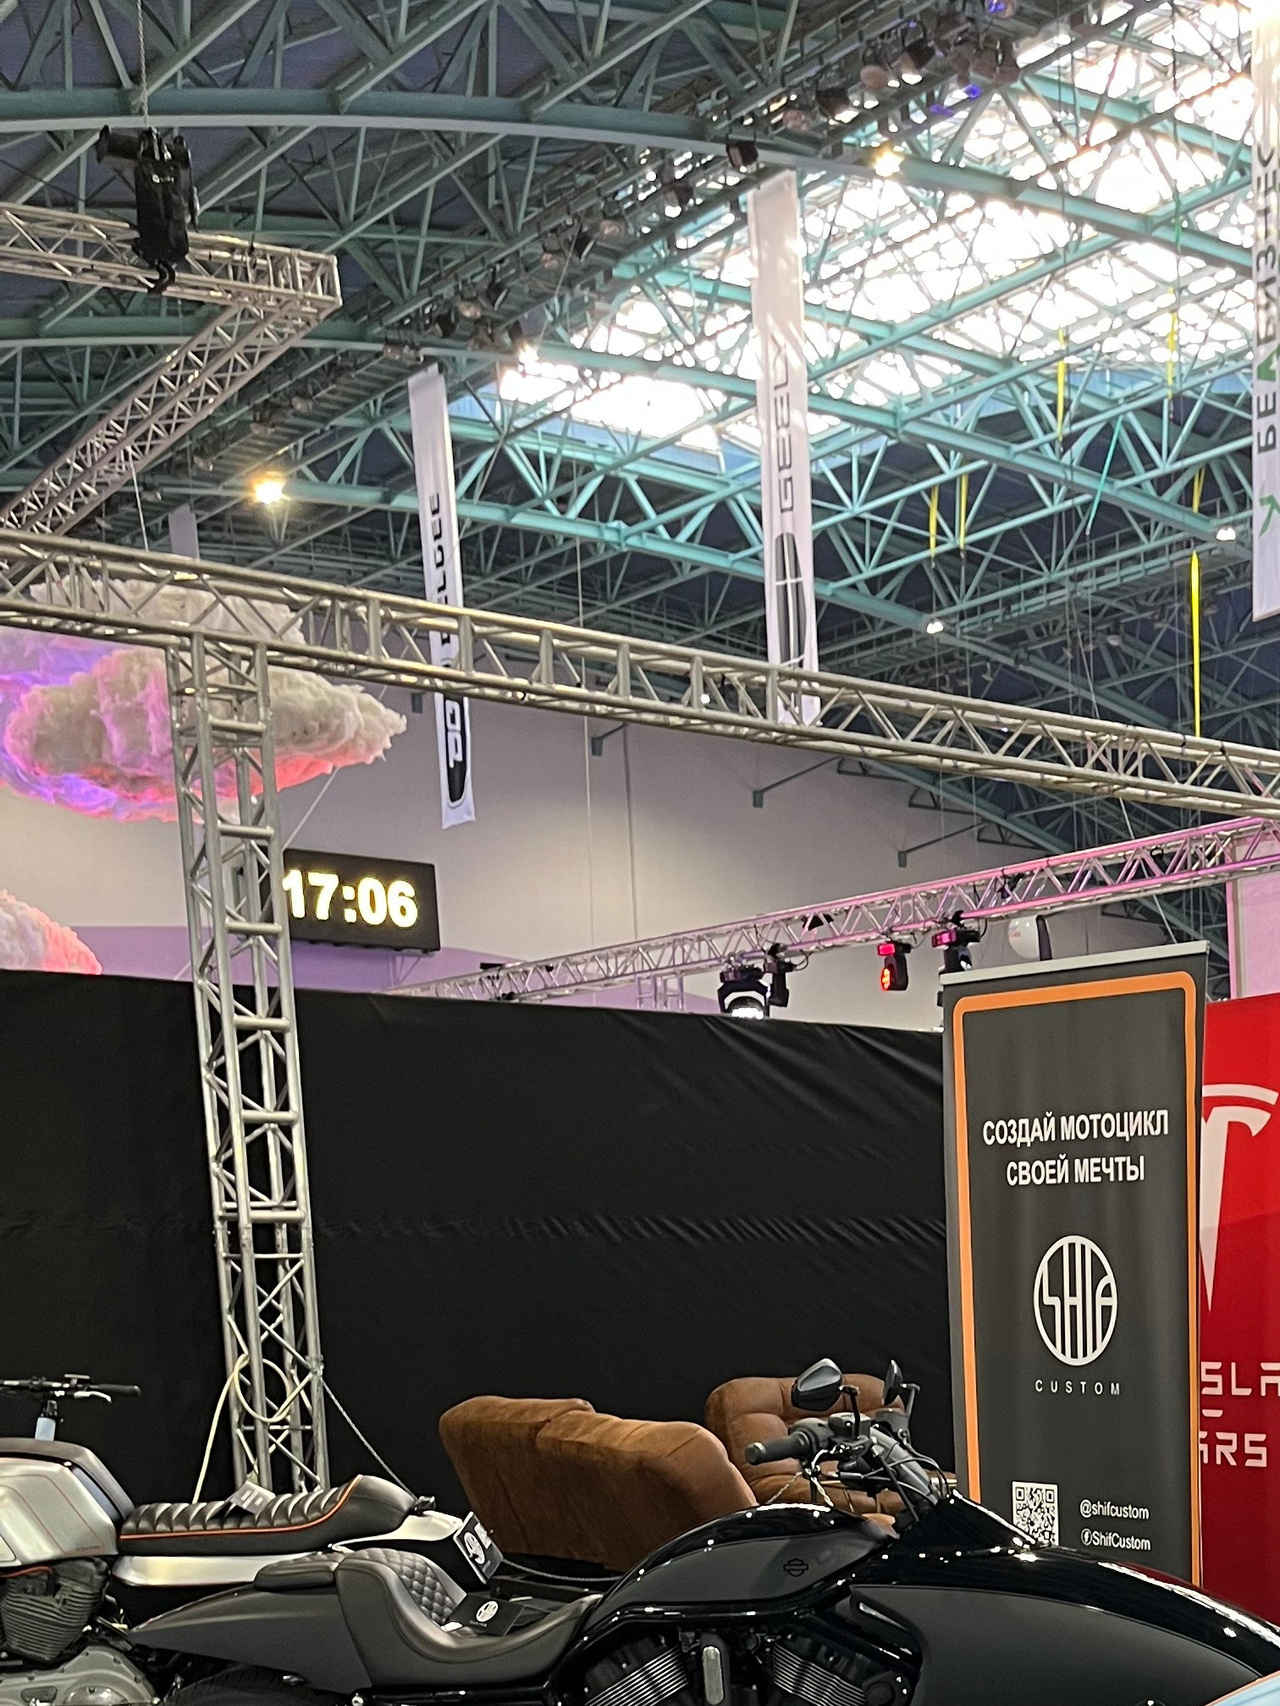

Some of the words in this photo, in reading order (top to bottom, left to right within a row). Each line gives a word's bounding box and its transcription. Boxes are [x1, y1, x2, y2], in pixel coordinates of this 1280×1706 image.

[771, 334, 795, 514] GEELY
[282, 869, 418, 928] 17:06
[982, 1111, 1056, 1148] СОЗДАЙ
[1060, 1109, 1169, 1142] МОТОЦИКЛ
[1006, 1153, 1069, 1186] СВОЕЙ
[1074, 1155, 1146, 1184] МЕЧТЫ
[1035, 1379, 1120, 1396] CUSTOM
[1080, 1499, 1150, 1520] @shifcustom
